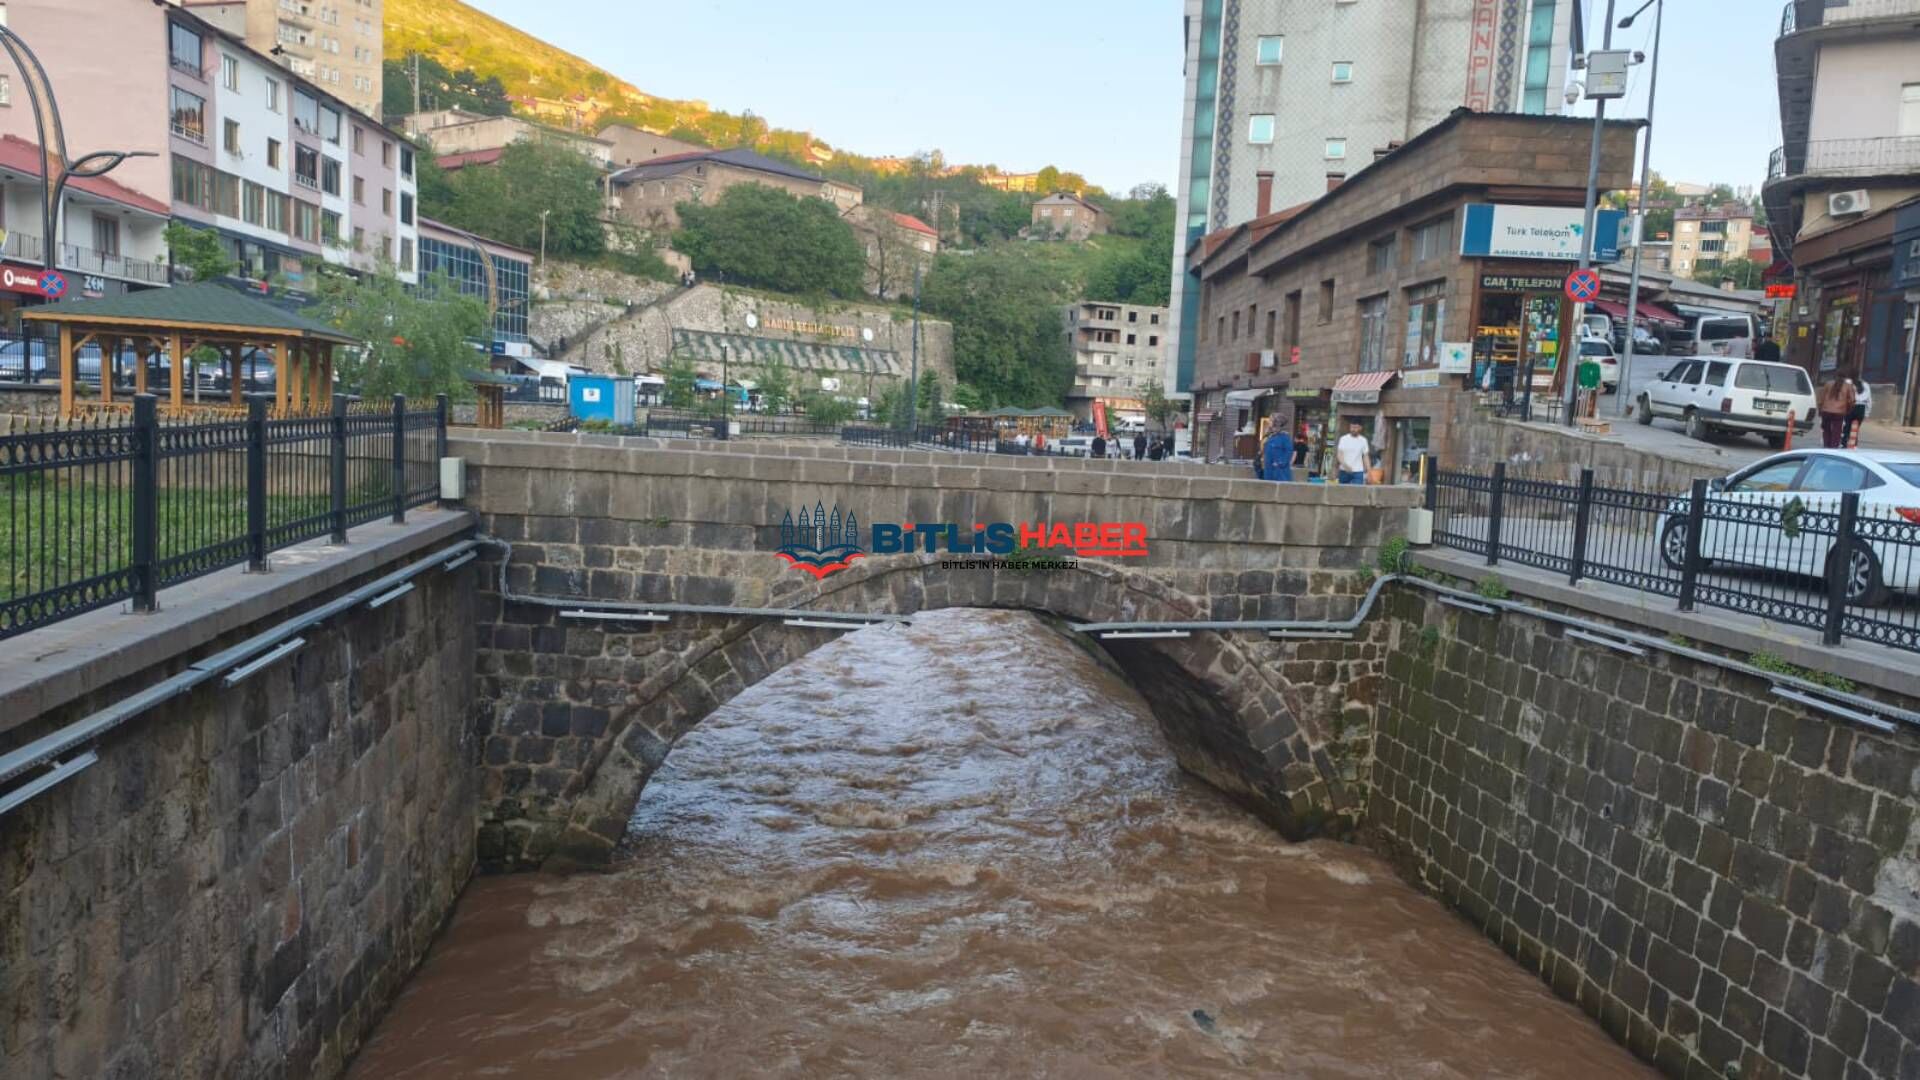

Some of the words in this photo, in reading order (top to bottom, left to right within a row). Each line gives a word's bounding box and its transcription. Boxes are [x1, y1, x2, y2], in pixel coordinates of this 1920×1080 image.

[1475, 0, 1494, 50] AN
[1506, 226, 1526, 236] Türk
[1530, 227, 1570, 238] Telekom
[1483, 276, 1508, 288] CAN
[1510, 278, 1562, 288] TELEFON
